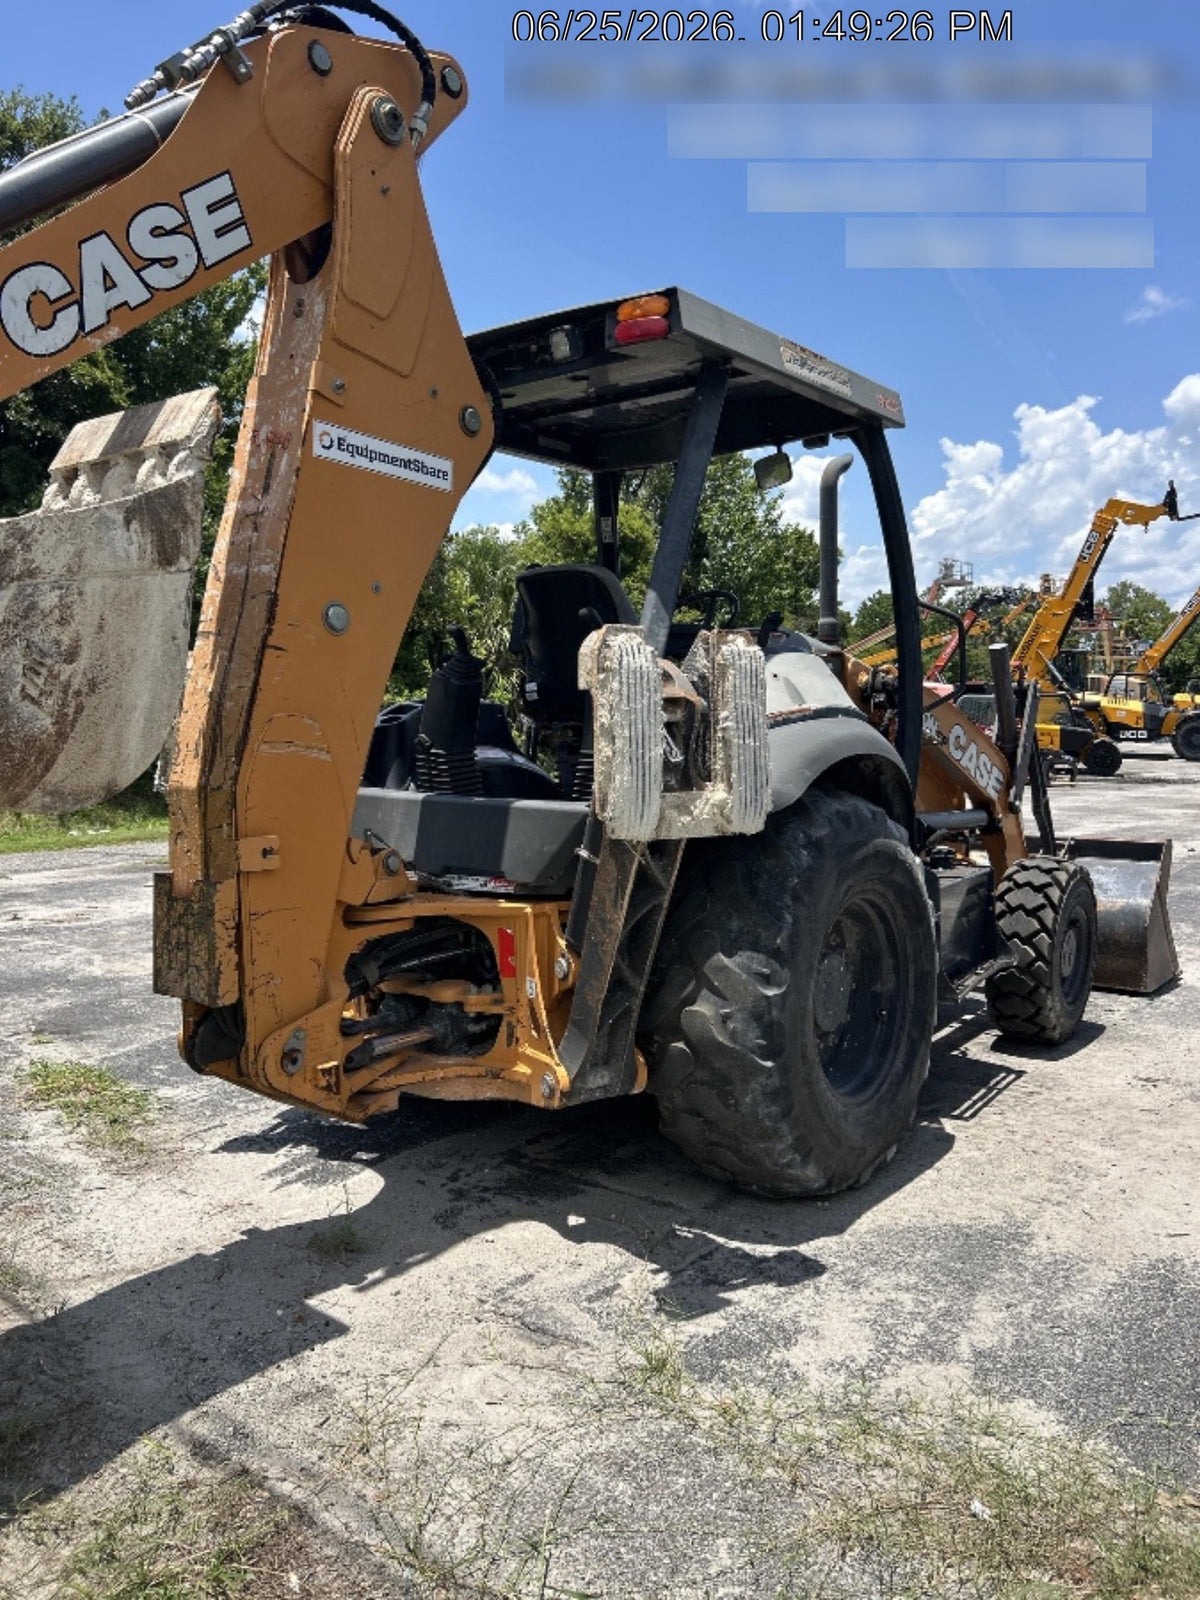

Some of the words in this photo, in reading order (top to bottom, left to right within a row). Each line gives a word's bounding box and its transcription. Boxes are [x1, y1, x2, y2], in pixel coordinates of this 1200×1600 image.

[0, 169, 253, 358] CASE
[336, 436, 449, 481] EquipmentShare
[1079, 530, 1100, 563] JCB
[948, 723, 1005, 800] CASE
